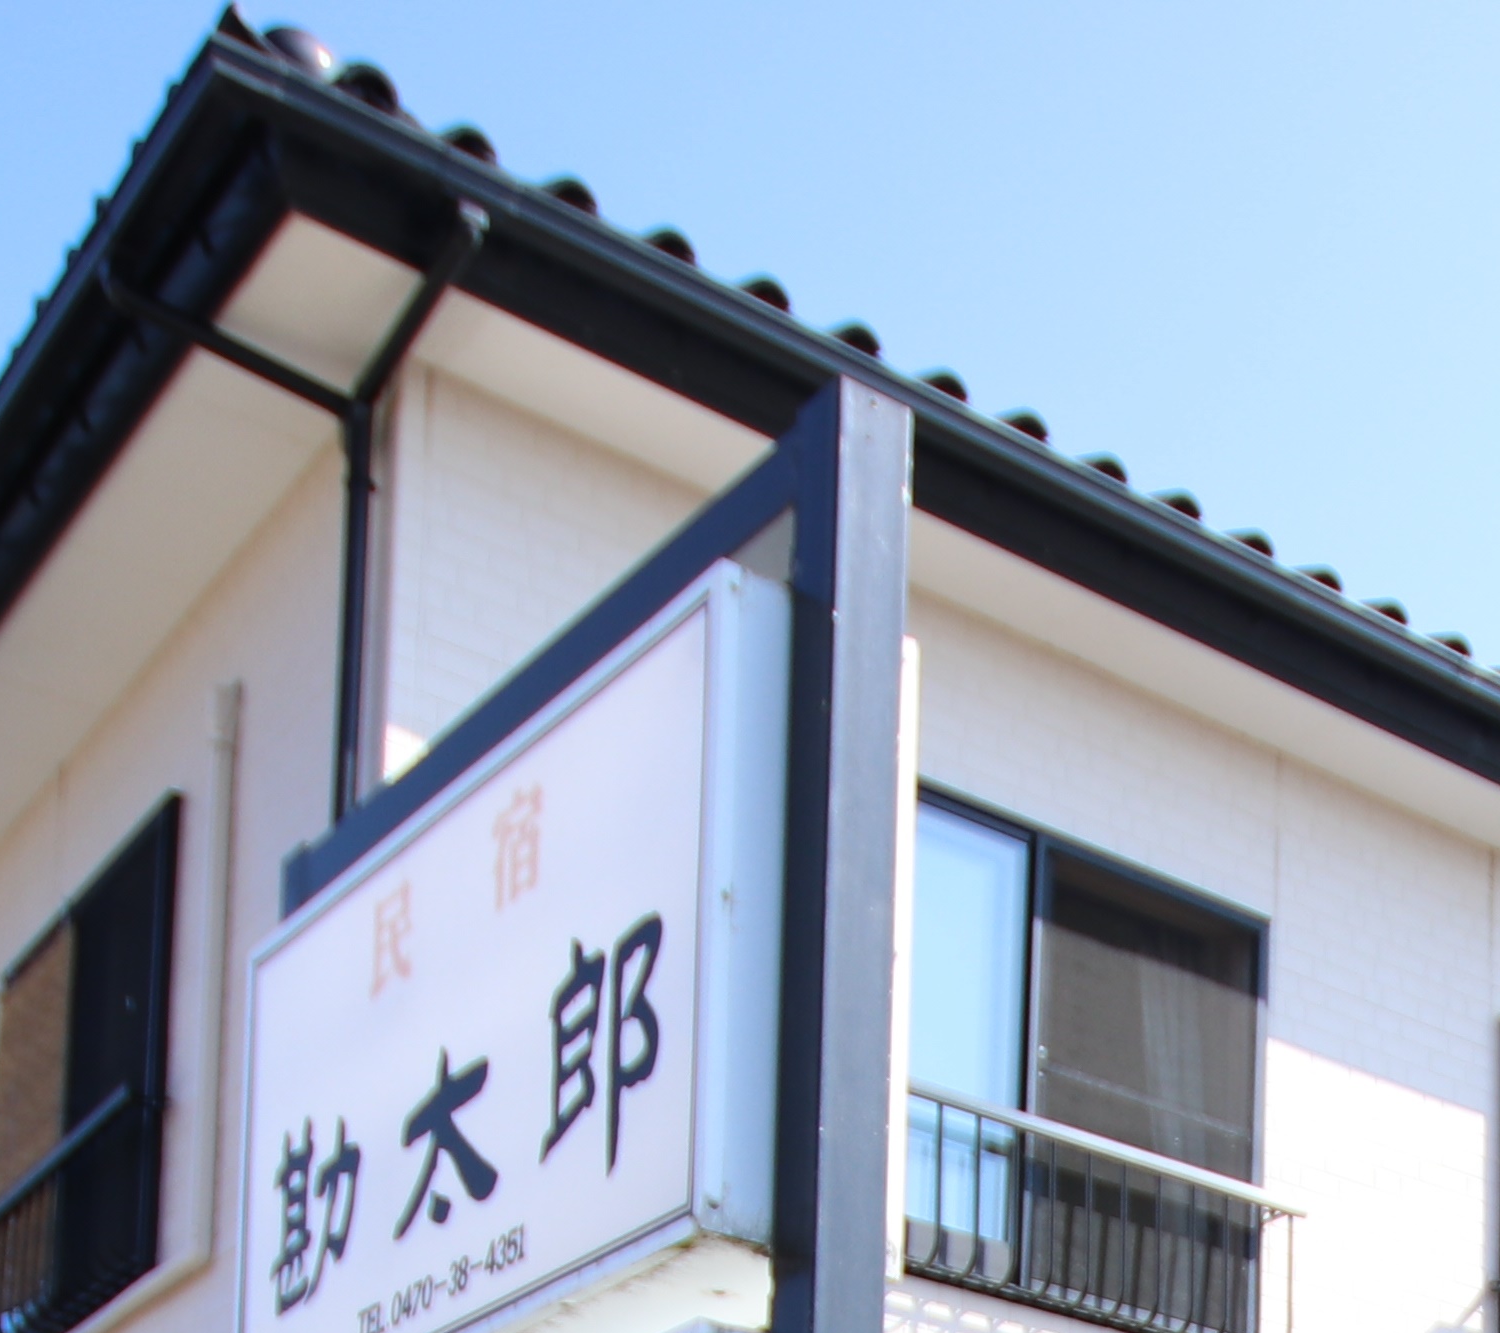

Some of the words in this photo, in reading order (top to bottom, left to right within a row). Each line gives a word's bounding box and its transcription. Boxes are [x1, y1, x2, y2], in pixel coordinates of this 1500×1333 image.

[370, 784, 544, 1000] 民宿
[269, 909, 664, 1317] 勘太郎
